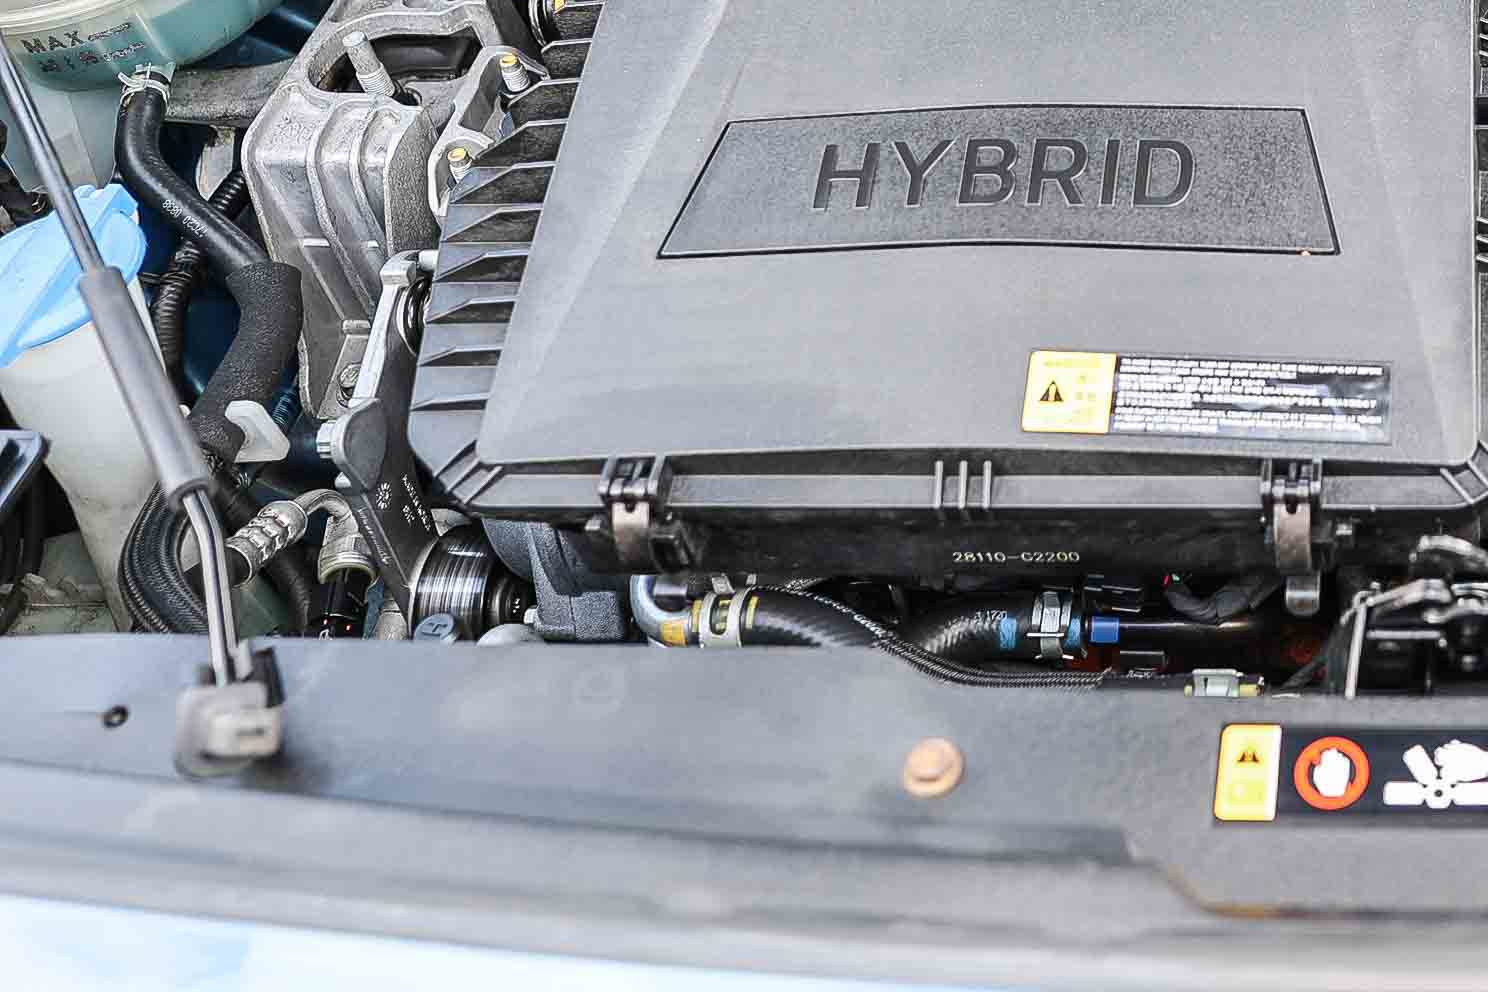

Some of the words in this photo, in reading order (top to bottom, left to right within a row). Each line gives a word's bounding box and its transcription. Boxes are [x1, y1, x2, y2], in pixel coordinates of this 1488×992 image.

[20, 30, 85, 54] MAX
[812, 137, 1196, 209] HYBRID
[952, 551, 1080, 563] 28110-C2200
